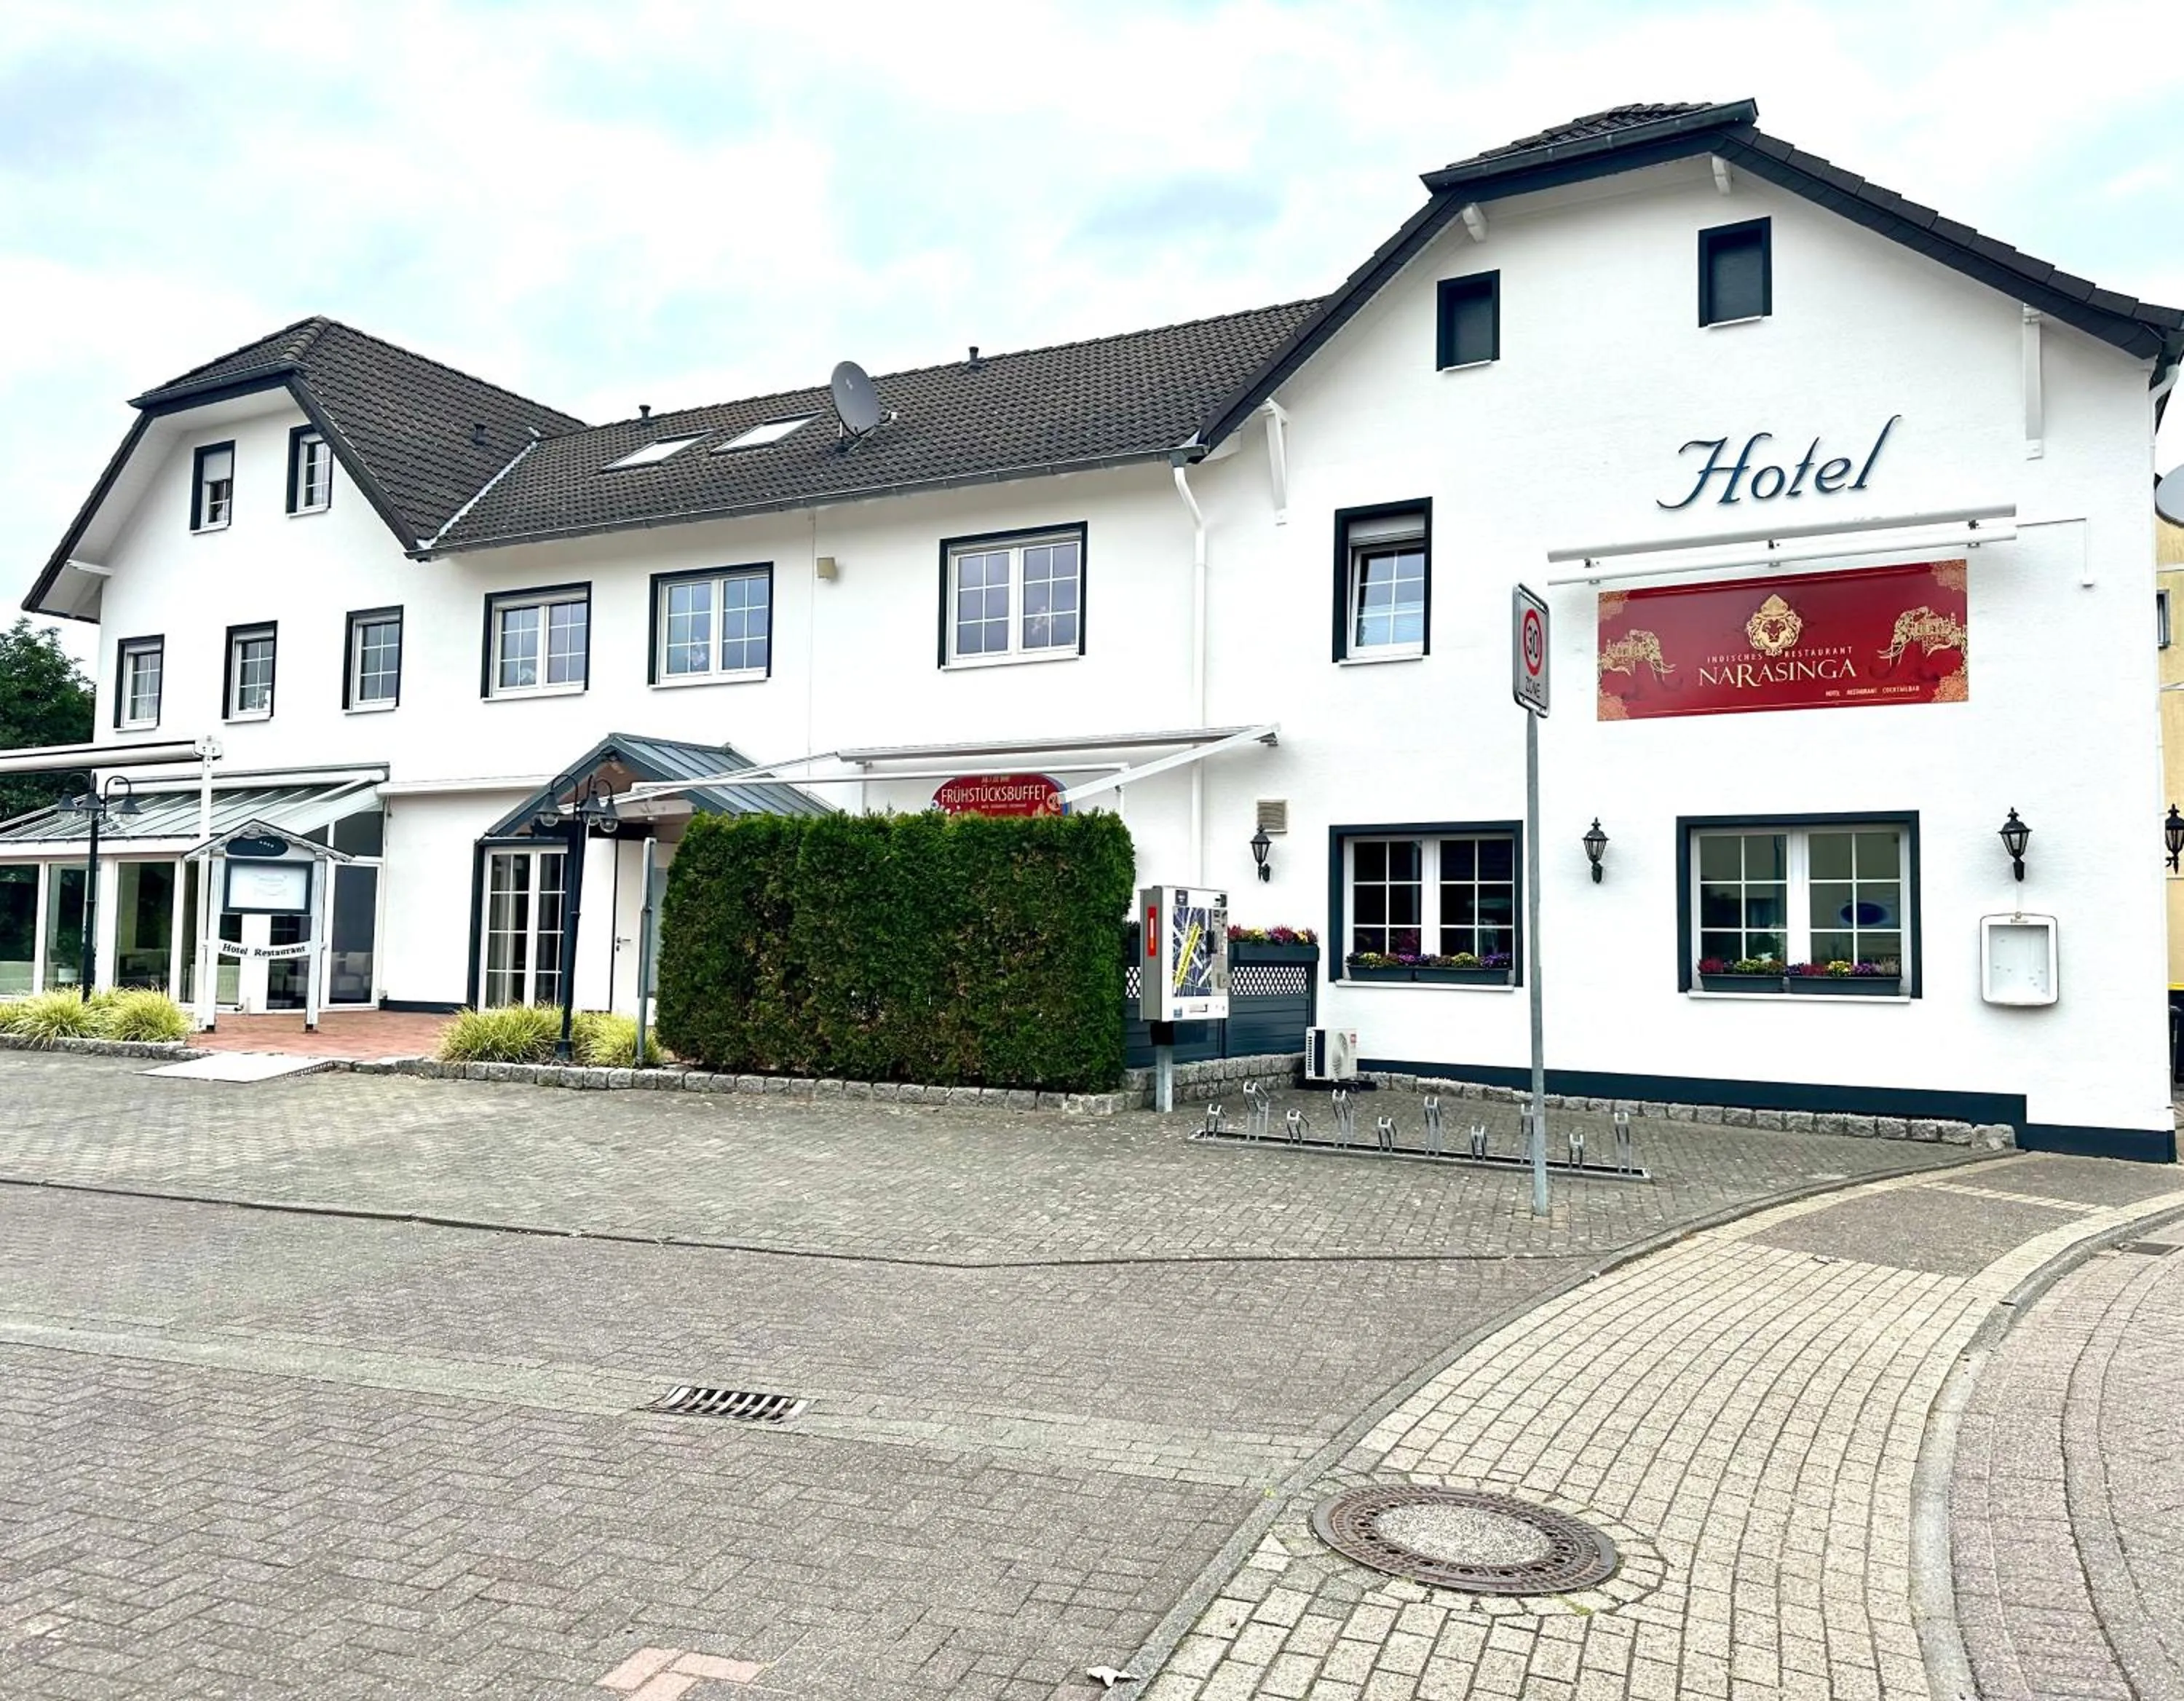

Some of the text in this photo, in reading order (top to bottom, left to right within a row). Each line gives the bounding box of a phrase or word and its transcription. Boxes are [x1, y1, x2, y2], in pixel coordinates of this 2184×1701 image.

[1656, 414, 1902, 509] Hotel
[1527, 625, 1539, 658] 30
[1706, 646, 1853, 663] INDISCHES RESTAURANT
[1698, 658, 1857, 688] NARASINGA
[941, 784, 1048, 803] FRÜHSTÜCKSBUFFET
[222, 943, 306, 957] Hotel Restaurant
